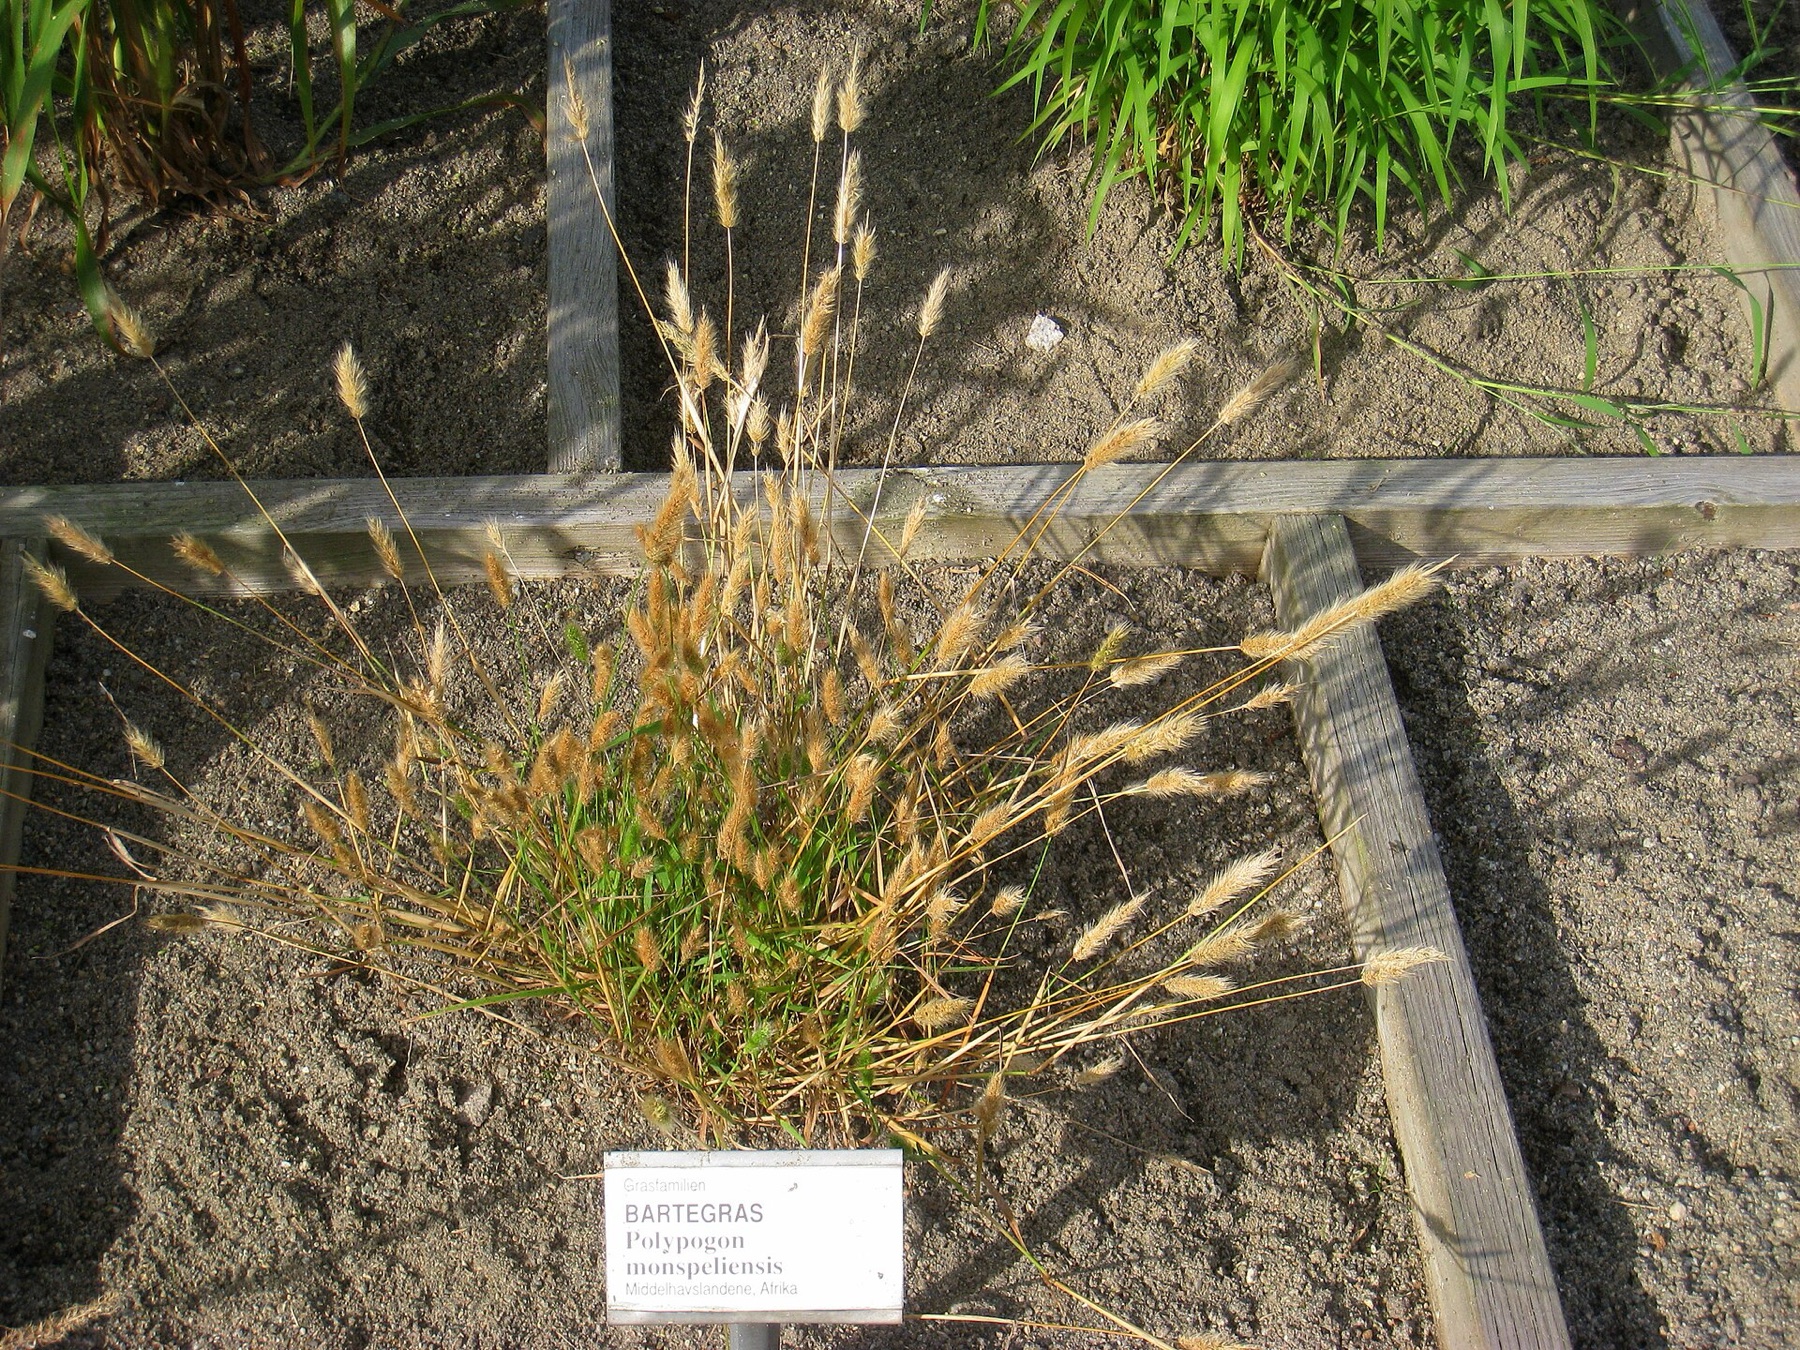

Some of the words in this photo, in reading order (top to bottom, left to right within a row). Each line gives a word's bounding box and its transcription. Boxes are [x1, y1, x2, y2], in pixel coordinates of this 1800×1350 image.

[624, 1203, 764, 1224] BARTEGRAS
[626, 1231, 745, 1254] Polypogon
[626, 1256, 783, 1279] monspeliensis
[625, 1281, 756, 1297] Middelhavslandene,
[760, 1281, 798, 1296] Afrika
